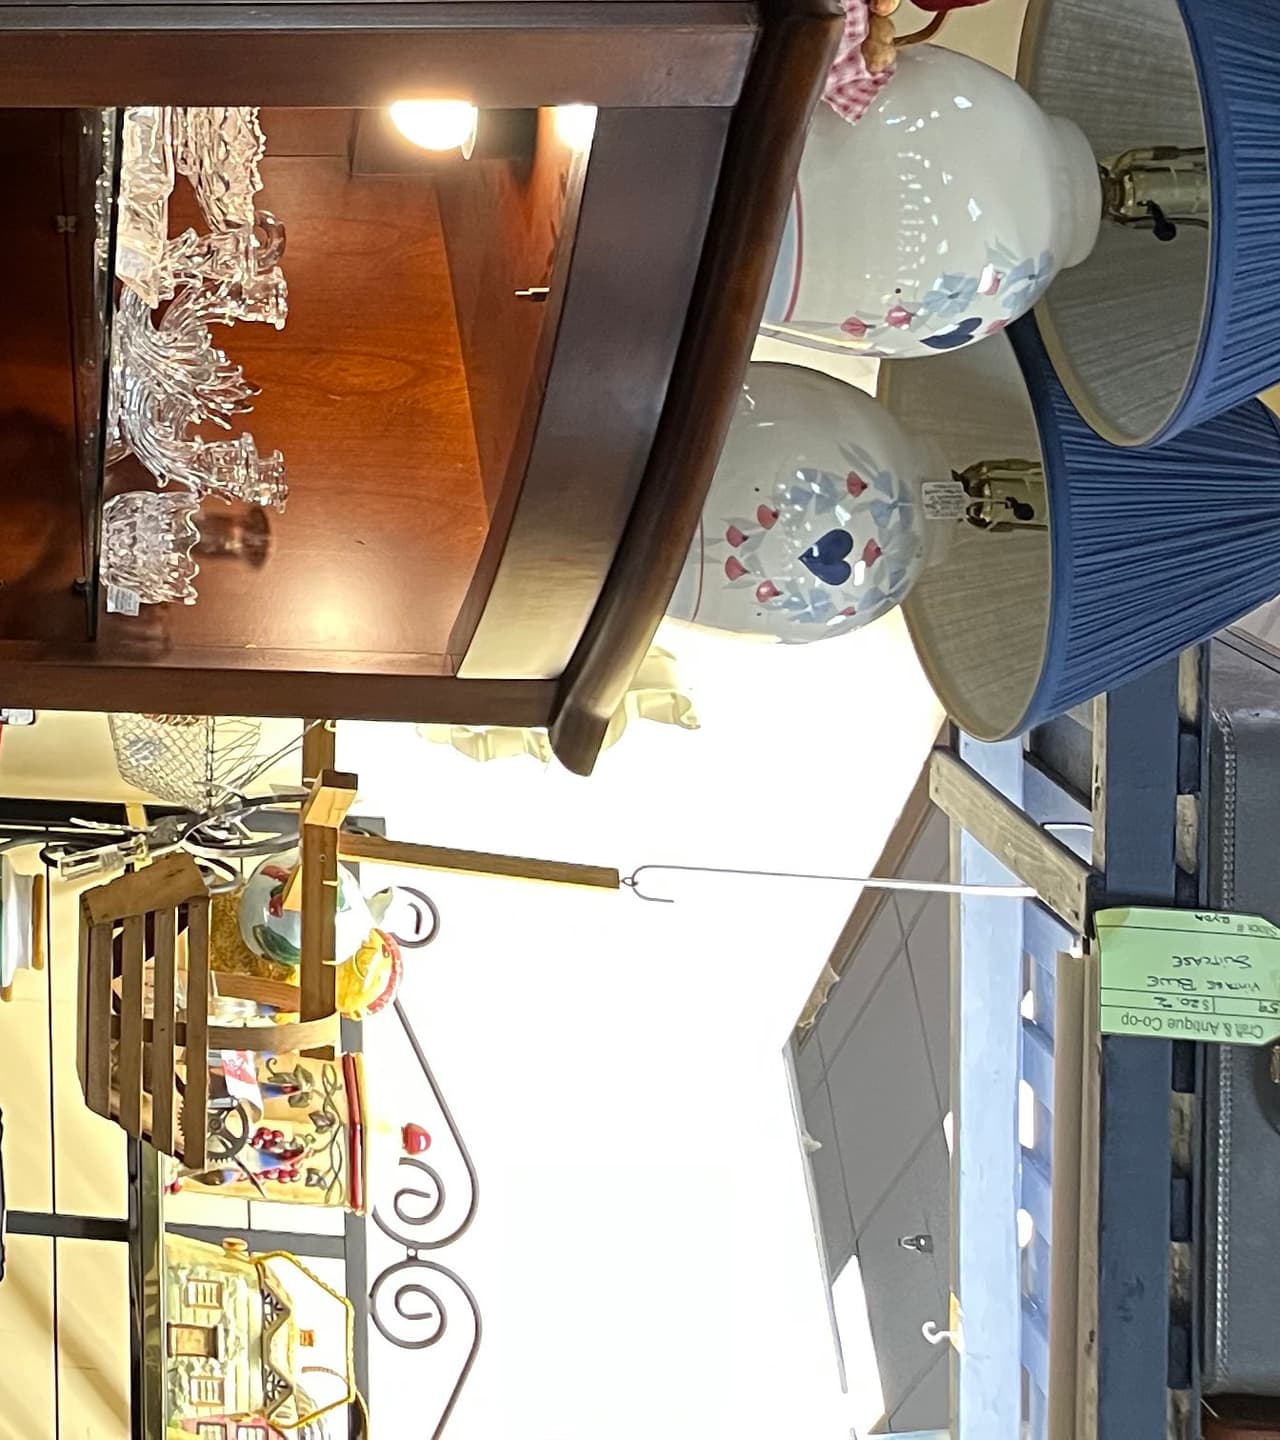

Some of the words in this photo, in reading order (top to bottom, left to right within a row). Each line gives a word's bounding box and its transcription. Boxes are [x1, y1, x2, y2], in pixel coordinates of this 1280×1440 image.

[1147, 975, 1197, 991] BLUE
[1121, 1011, 1163, 1031] Co-op
[1167, 1016, 1220, 1036] Antique
[1222, 1021, 1233, 1038] &
[1235, 1022, 1264, 1040] Craft
